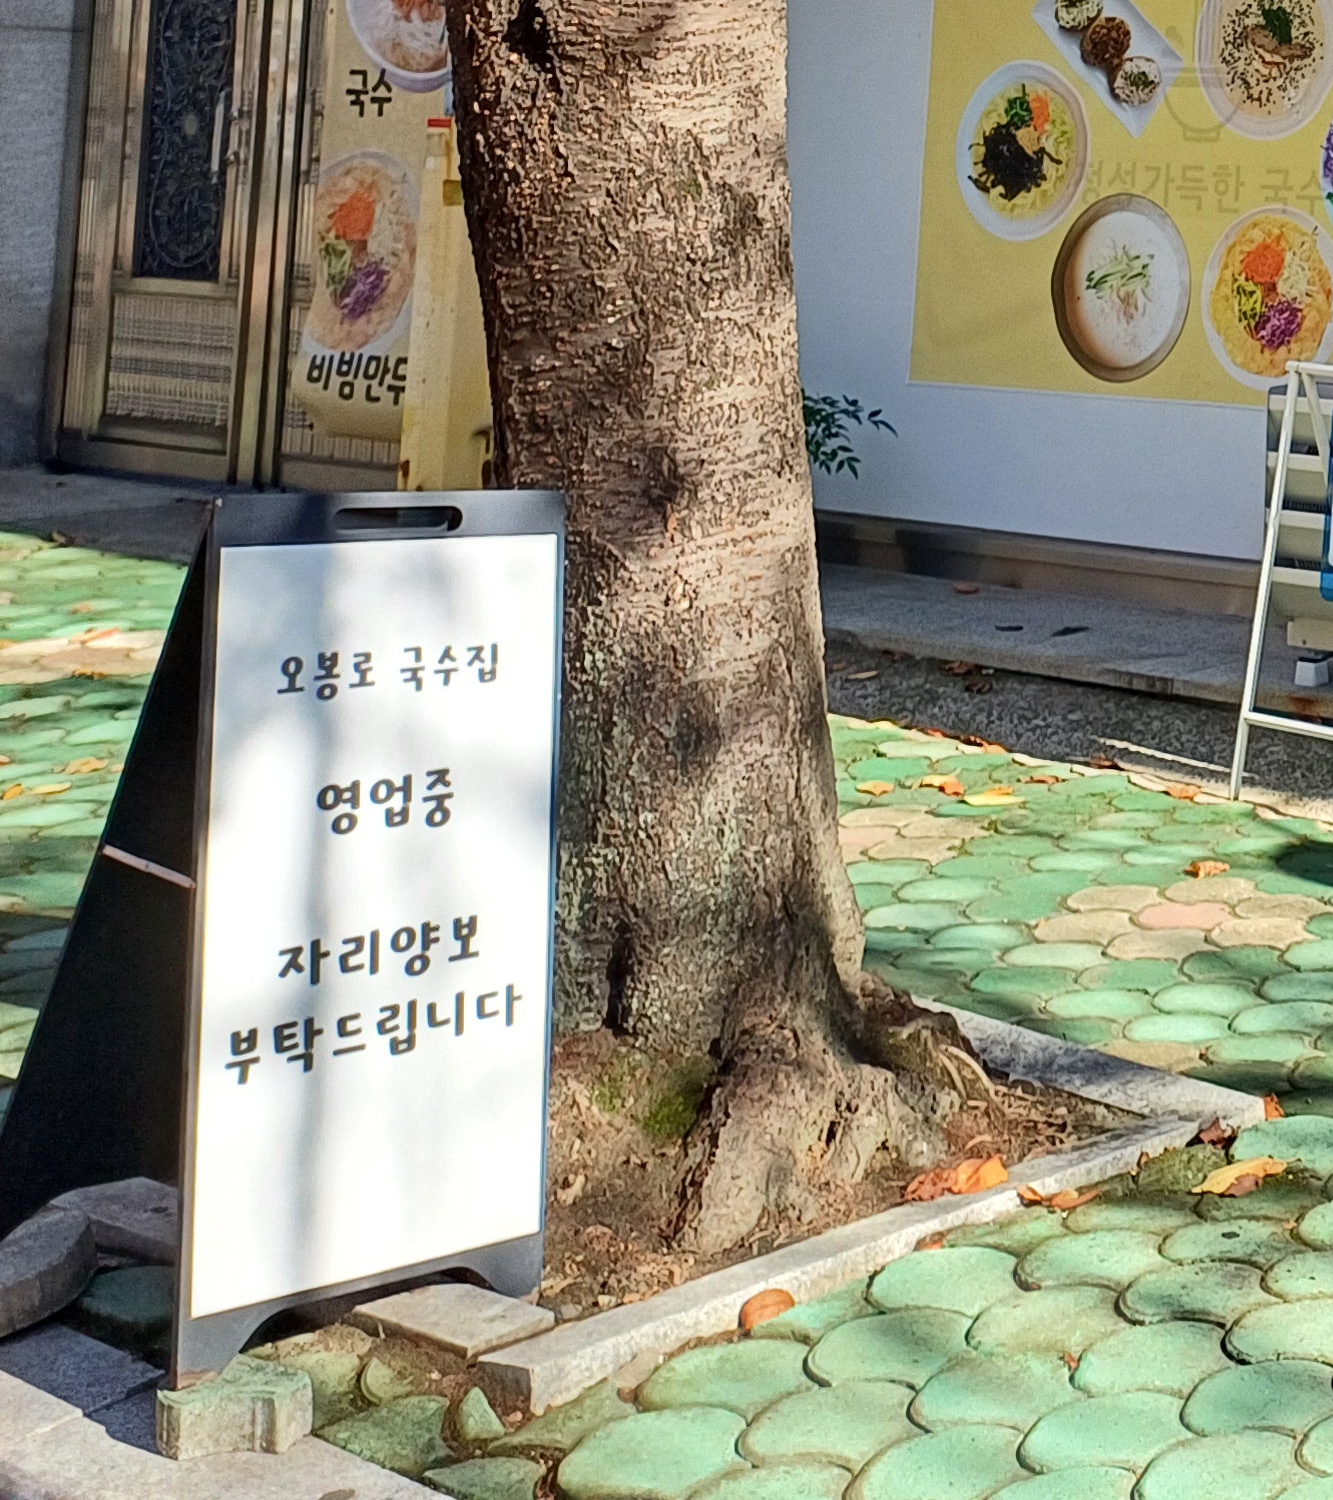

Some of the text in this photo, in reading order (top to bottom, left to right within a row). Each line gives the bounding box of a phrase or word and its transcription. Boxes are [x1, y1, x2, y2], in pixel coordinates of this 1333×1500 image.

[345, 67, 393, 118] 국수
[306, 350, 409, 407] 비빔만두
[276, 642, 499, 702] 오봉로 국수집
[316, 767, 455, 835] 영업중
[278, 914, 480, 987] 자리양보
[224, 982, 524, 1086] 부탁드립니다
